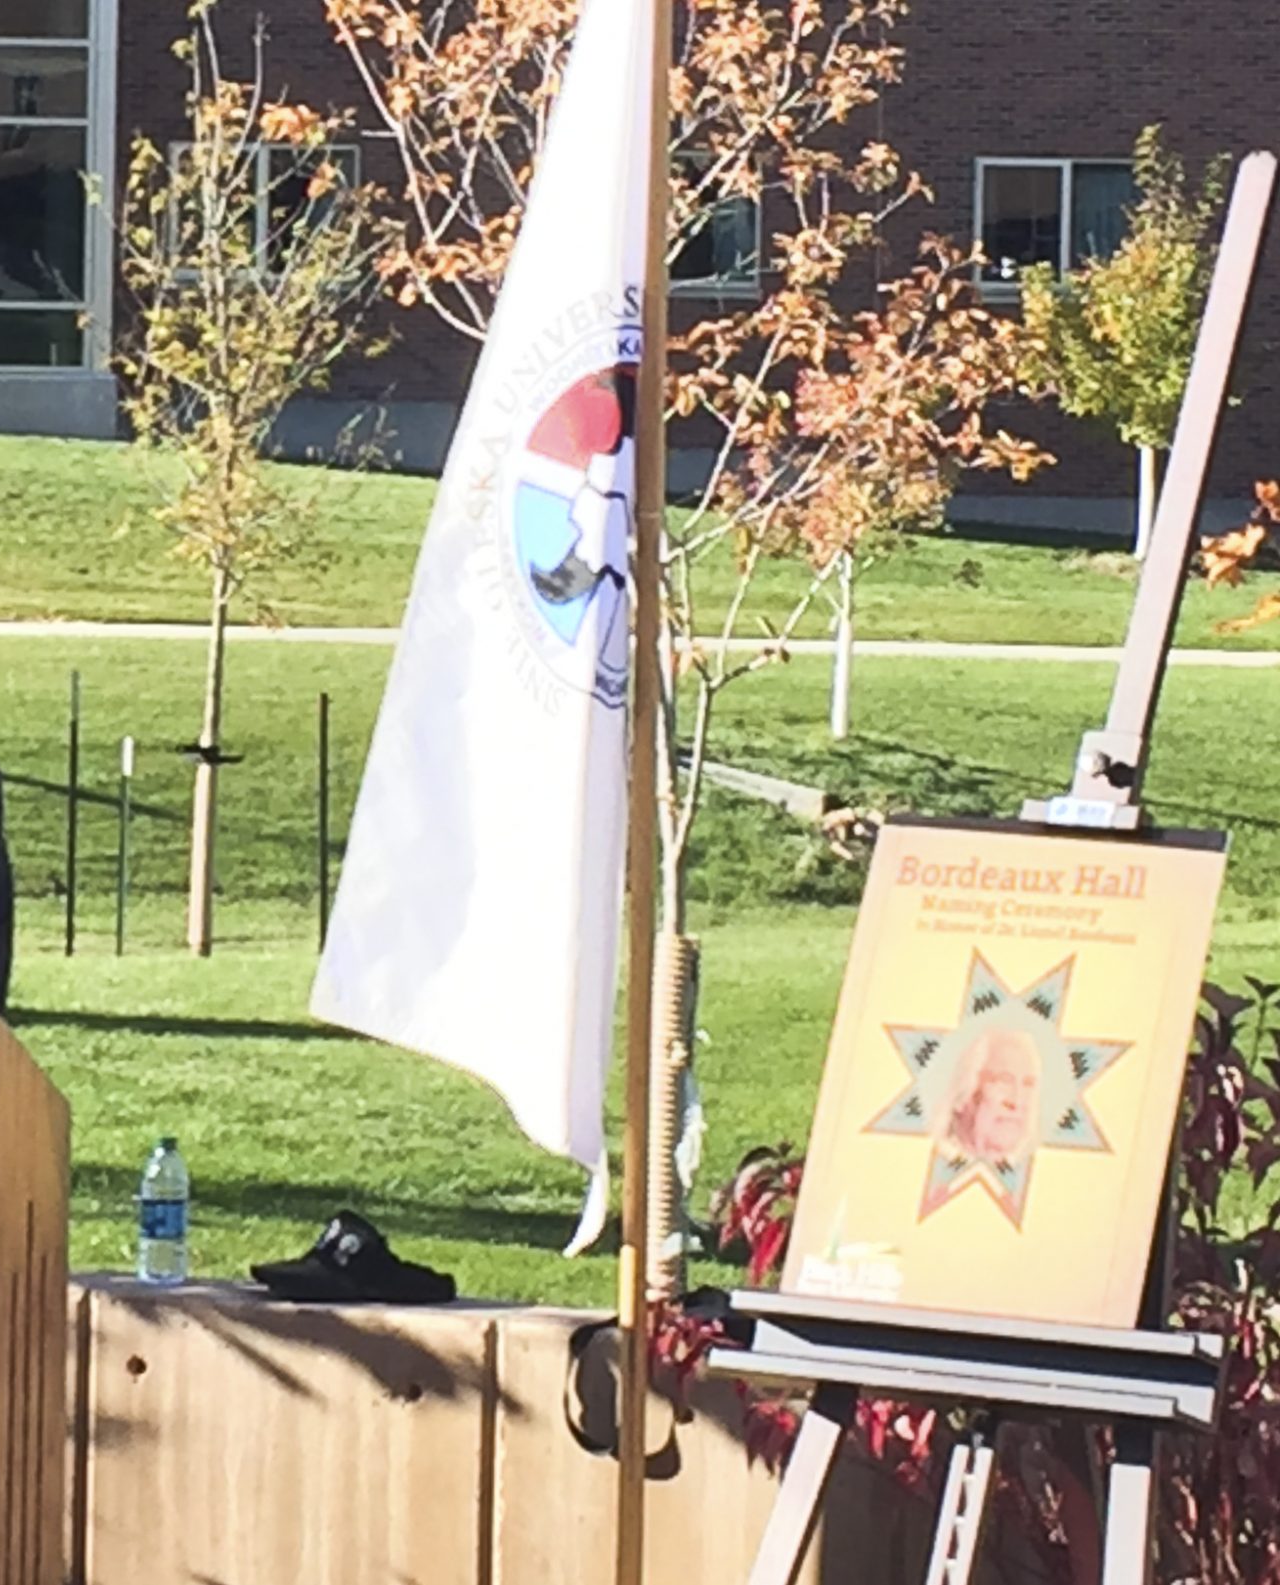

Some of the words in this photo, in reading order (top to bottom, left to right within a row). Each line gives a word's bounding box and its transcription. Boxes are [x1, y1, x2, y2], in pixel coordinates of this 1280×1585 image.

[493, 284, 640, 415] UNIVERS
[896, 856, 1065, 894] Bordeaux
[1071, 865, 1148, 899] Hall
[922, 894, 995, 920] Naming
[1001, 899, 1103, 926] Ceremony
